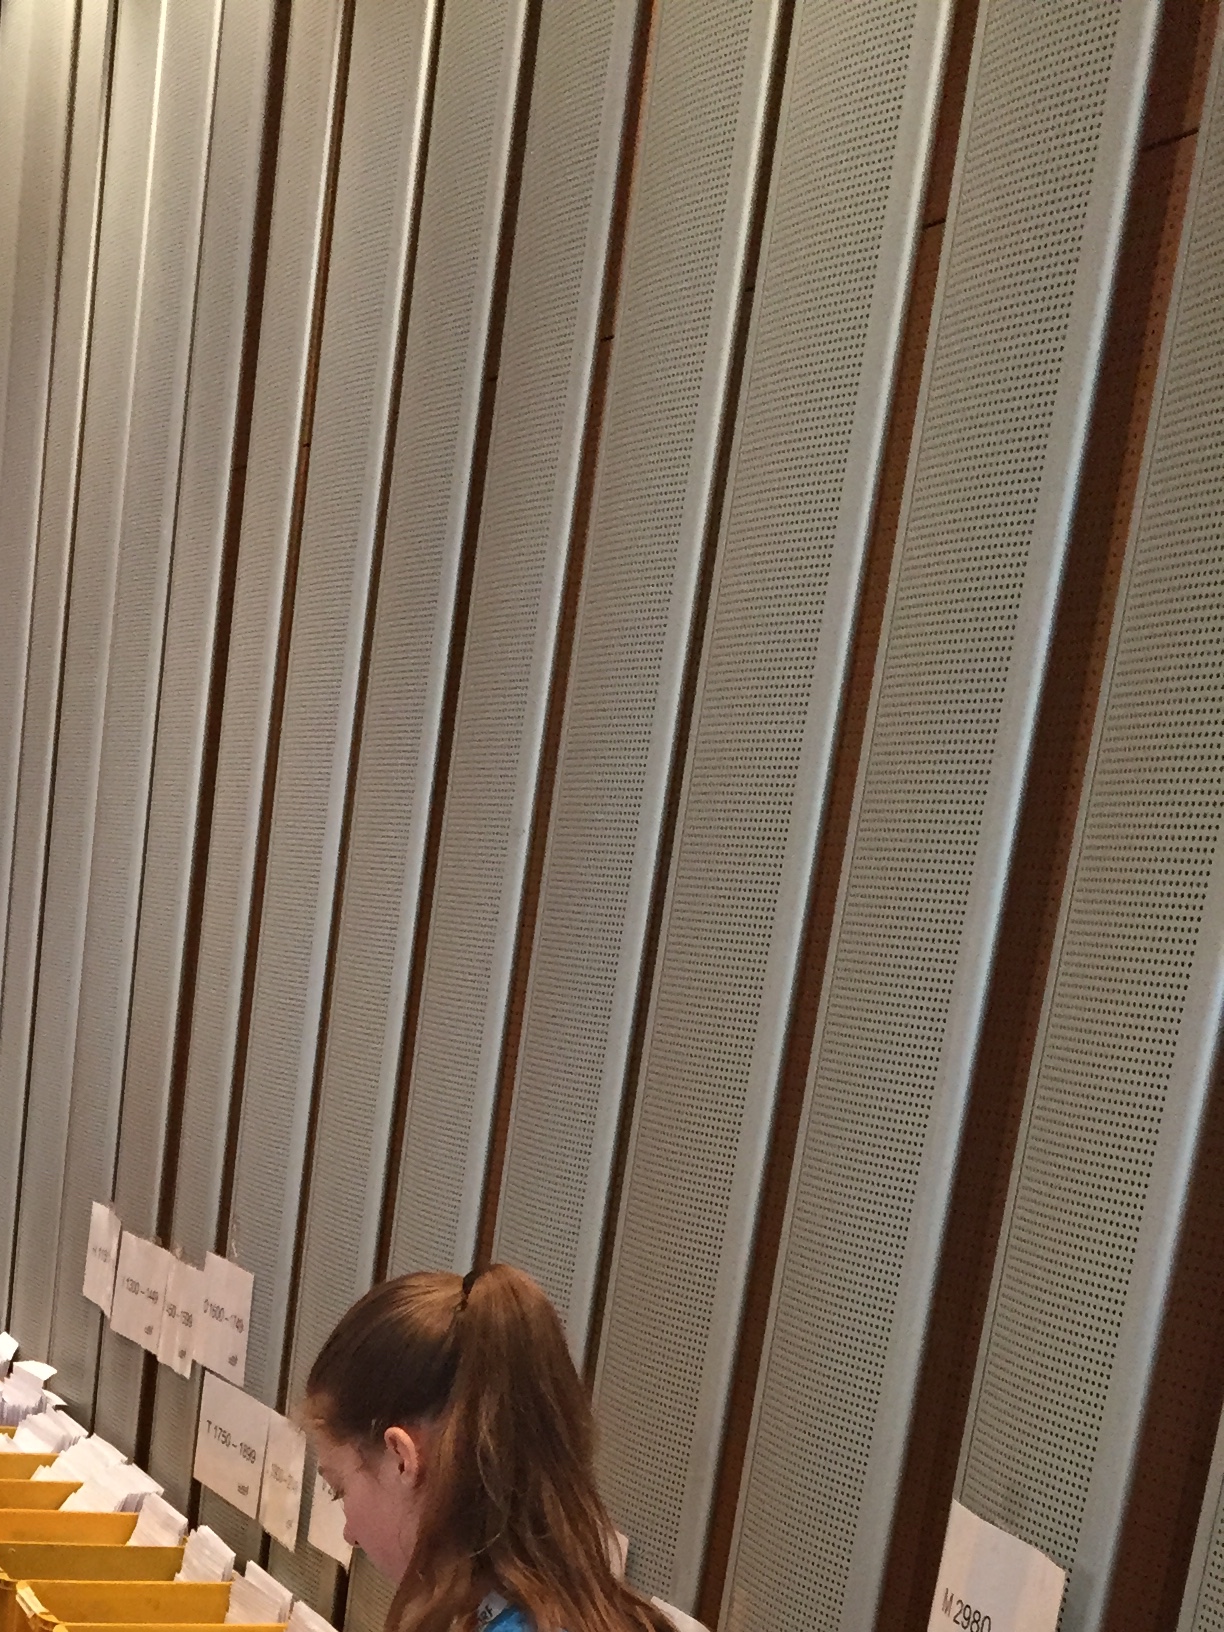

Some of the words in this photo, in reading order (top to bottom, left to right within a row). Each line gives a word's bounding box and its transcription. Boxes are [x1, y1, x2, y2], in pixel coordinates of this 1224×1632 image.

[206, 1420, 212, 1433] T
[213, 1426, 232, 1448] 1750
[239, 1442, 257, 1464] 1899
[941, 1587, 955, 1617] M
